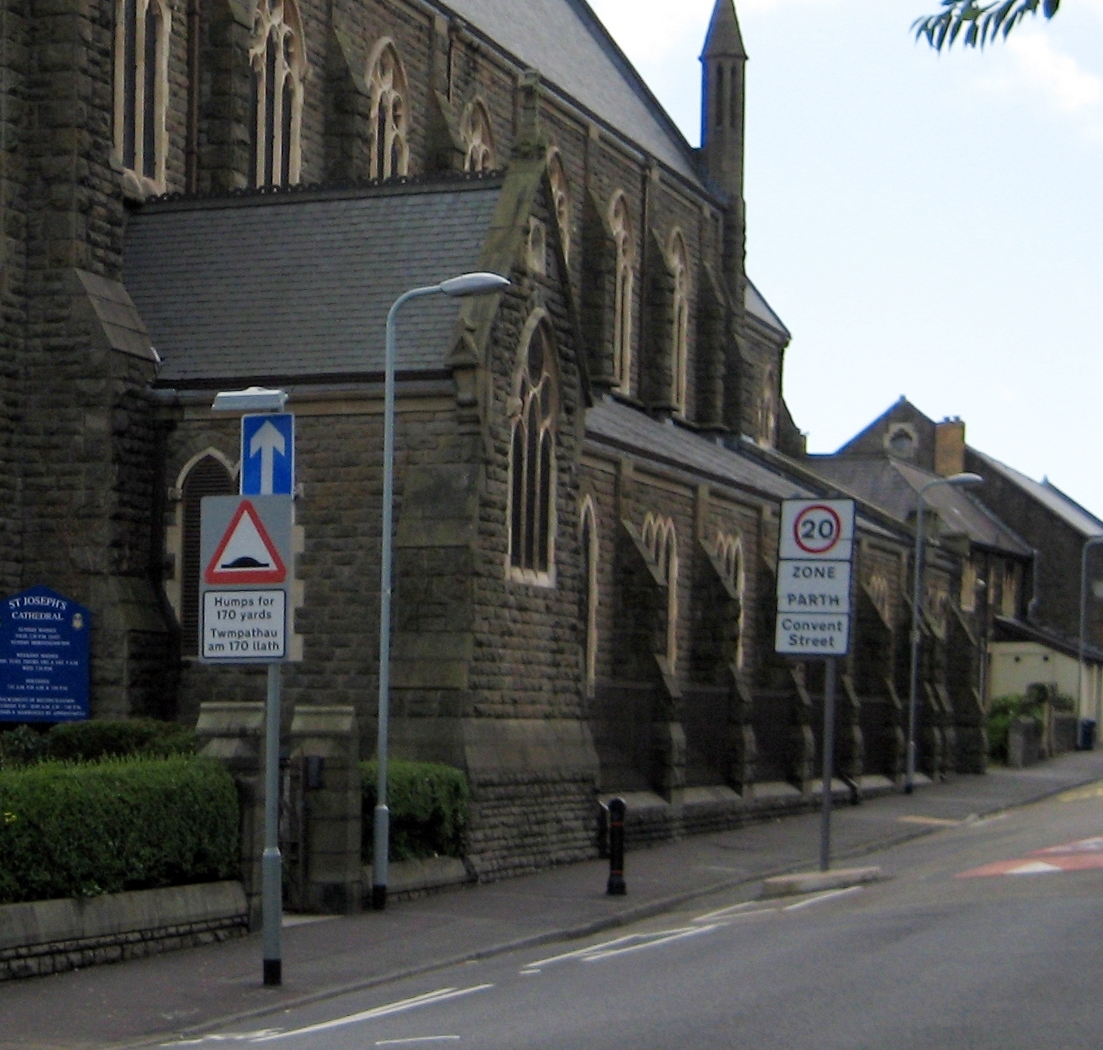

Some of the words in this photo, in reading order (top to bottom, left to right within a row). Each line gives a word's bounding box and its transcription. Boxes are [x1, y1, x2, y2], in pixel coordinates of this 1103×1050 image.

[800, 518, 834, 539] 20
[792, 566, 835, 579] ZONE
[8, 598, 21, 609] ST
[23, 596, 67, 610] JOSEPH'S
[214, 596, 254, 608] Humps
[258, 596, 275, 606] for
[787, 593, 840, 606] PARTH
[11, 611, 64, 621] CATHEDRAL
[217, 609, 236, 620] 170
[240, 610, 272, 621] yards
[781, 619, 843, 632] Convent
[210, 628, 278, 639] Twmpathau
[208, 643, 225, 651] am
[229, 640, 249, 651] 170
[252, 641, 279, 651] llath
[788, 634, 835, 647] Street
